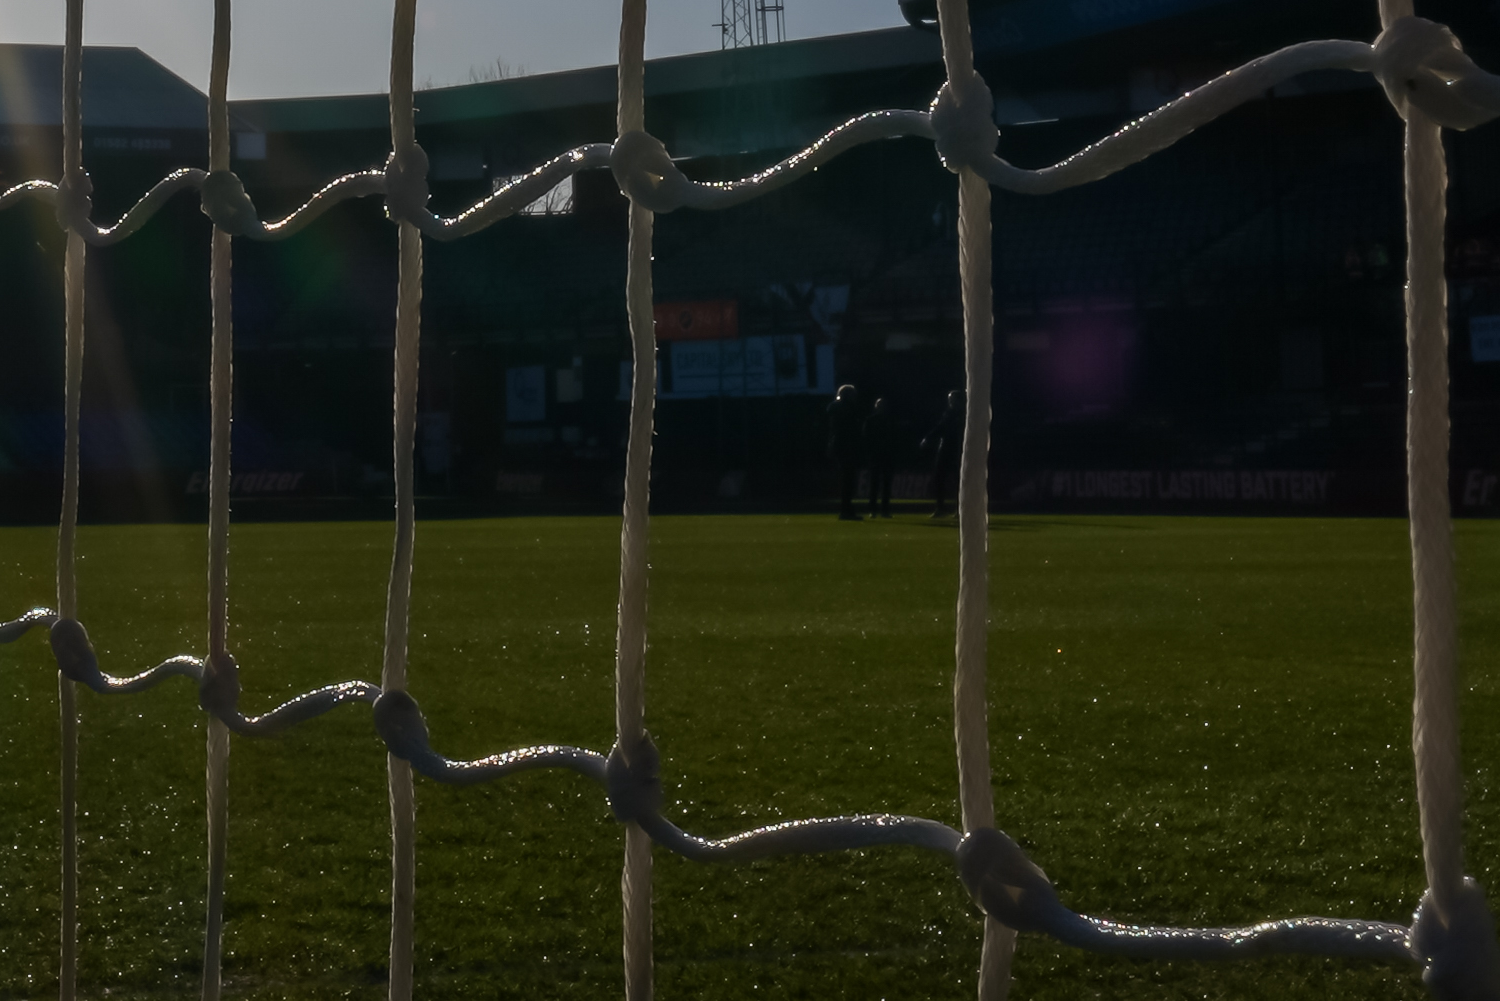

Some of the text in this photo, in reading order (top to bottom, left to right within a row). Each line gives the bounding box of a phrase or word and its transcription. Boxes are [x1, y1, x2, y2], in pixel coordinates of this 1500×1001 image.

[1075, 470, 1153, 498] LONGEST
[1158, 470, 1237, 499] LASTING
[1240, 470, 1328, 501] BATTERY
